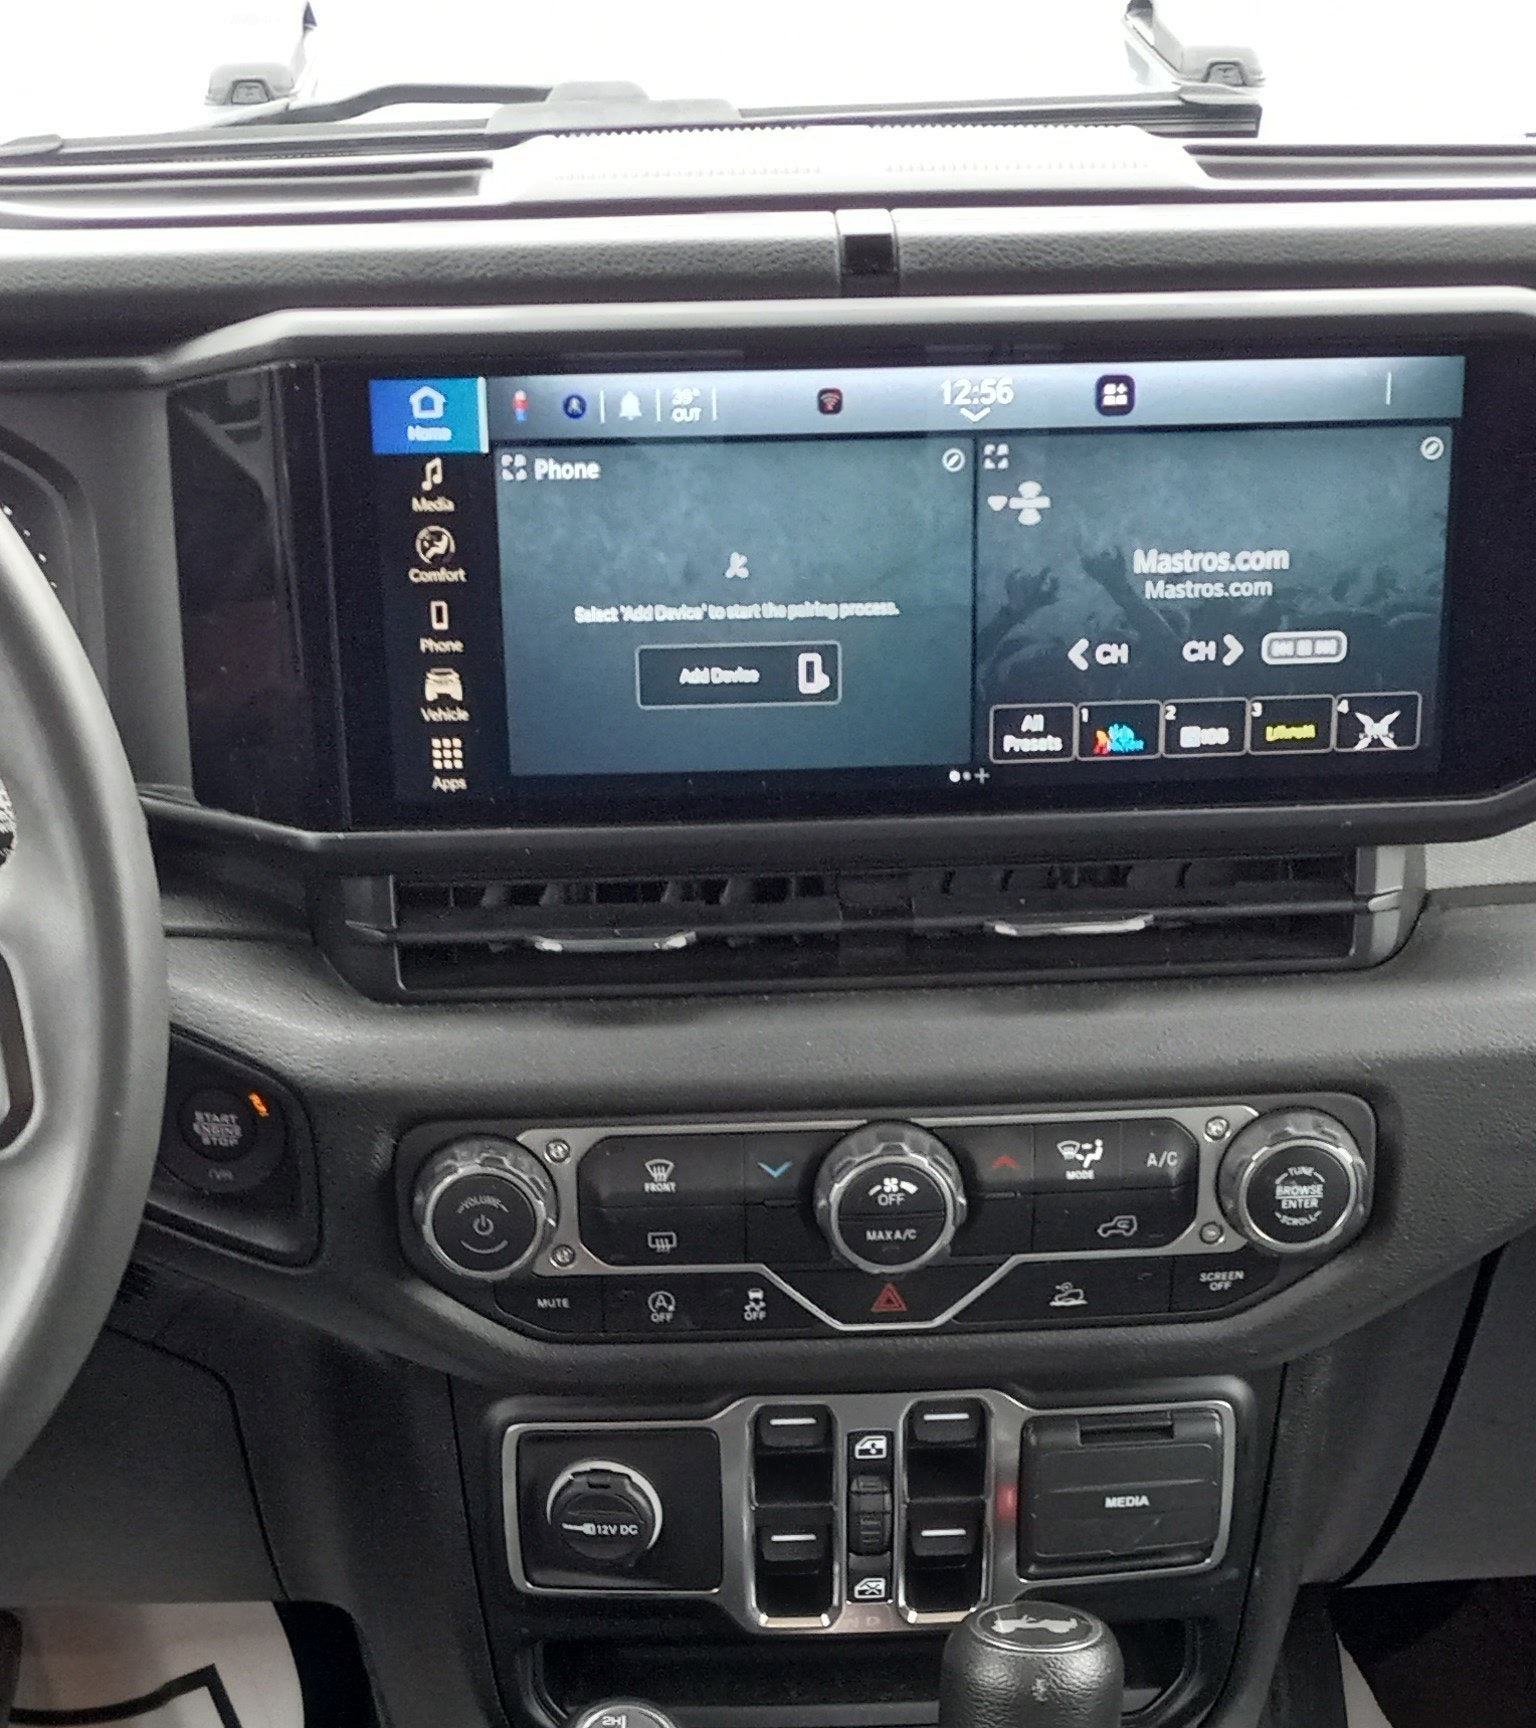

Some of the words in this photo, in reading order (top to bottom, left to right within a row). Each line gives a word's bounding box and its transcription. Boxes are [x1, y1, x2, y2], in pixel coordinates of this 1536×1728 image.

[941, 377, 1014, 405] 12:56
[672, 407, 702, 422] OUT
[534, 459, 601, 482] Phone
[412, 495, 455, 513] Media
[1133, 548, 1290, 574] Mastros.com
[409, 566, 466, 584] Comfort
[1145, 578, 1273, 600] Mastros.com
[762, 602, 787, 619] the
[420, 636, 463, 653] Phone
[1182, 641, 1216, 662] CH
[1095, 643, 1129, 665] CH
[679, 668, 710, 685] Add
[711, 666, 760, 684] Device
[421, 705, 469, 723] Vehicle
[1165, 705, 1176, 720] 2
[1251, 702, 1262, 717] 3
[1021, 714, 1044, 732] All
[1003, 734, 1063, 753] Presets
[432, 775, 467, 793] Apps
[1147, 1150, 1178, 1168] A/C
[1066, 1170, 1095, 1181] MODE
[644, 1181, 677, 1194] FRONT
[1275, 1184, 1324, 1196] BROWSE
[877, 1192, 906, 1206] OFF
[1281, 1197, 1319, 1209] ENTER
[865, 1229, 893, 1241] MAX
[894, 1228, 917, 1241] A/C
[1199, 1270, 1244, 1285] SCREEN
[1209, 1280, 1233, 1292] OFF
[536, 1298, 570, 1308] MUTE
[650, 1311, 674, 1323] OFF
[744, 1310, 767, 1322] OFF
[1104, 1492, 1150, 1510] MEDIA
[596, 1521, 618, 1537] 12V
[619, 1521, 639, 1537] DC
[601, 1715, 622, 1726] 2H
